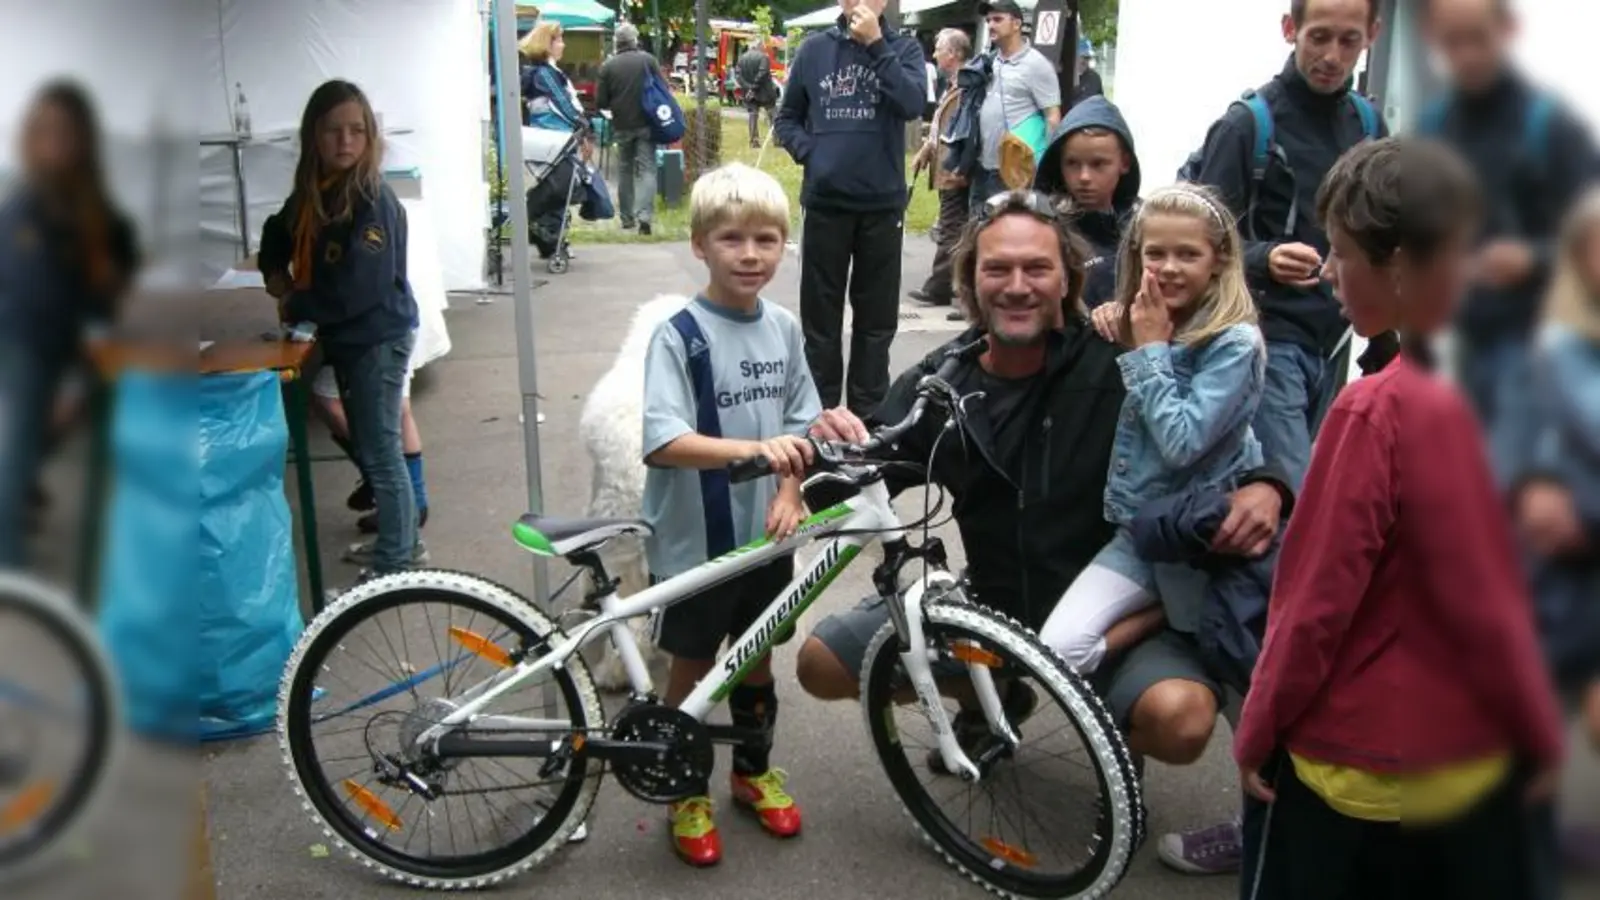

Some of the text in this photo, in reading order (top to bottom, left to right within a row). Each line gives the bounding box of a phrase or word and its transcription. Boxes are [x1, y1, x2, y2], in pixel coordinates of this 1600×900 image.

[740, 358, 784, 379] Sport
[716, 383, 787, 408] Grünber
[724, 539, 840, 681] Steppenwolf
